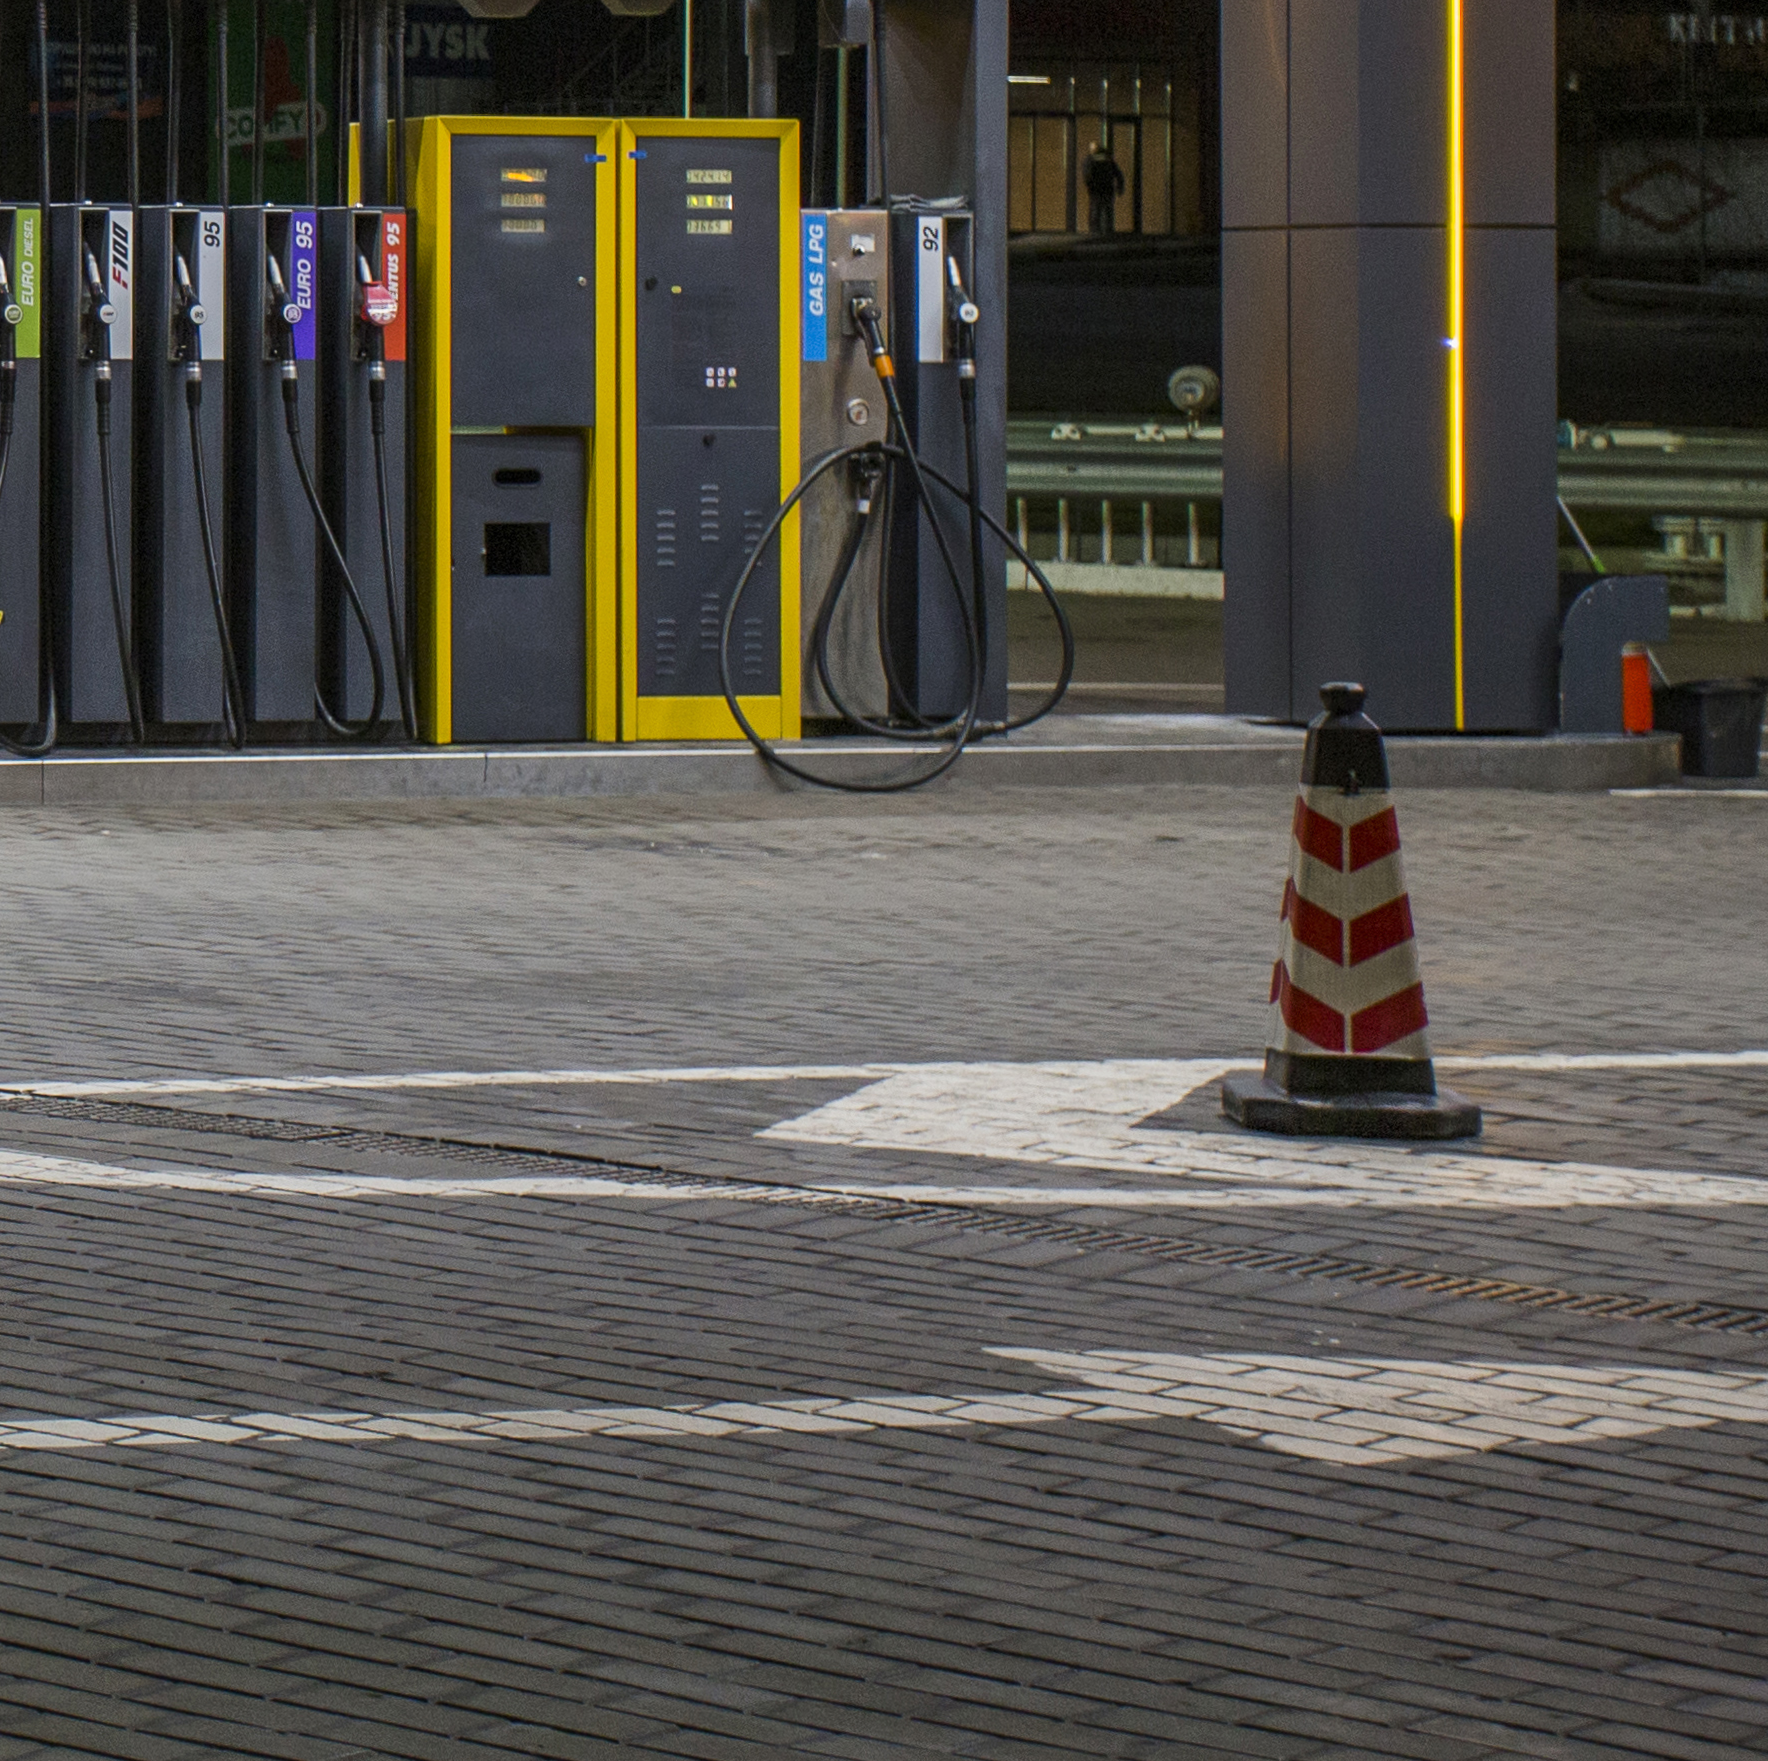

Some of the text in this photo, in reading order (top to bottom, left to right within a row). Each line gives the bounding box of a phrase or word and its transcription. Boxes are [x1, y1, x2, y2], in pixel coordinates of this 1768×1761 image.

[403, 22, 491, 61] JYSK
[21, 218, 34, 307] EURO DIESEL
[204, 221, 220, 247] 95
[296, 221, 313, 310] EURO 95
[387, 222, 400, 301] ENTUS 95
[809, 224, 824, 316] GAS LPG
[923, 226, 938, 252] 92
